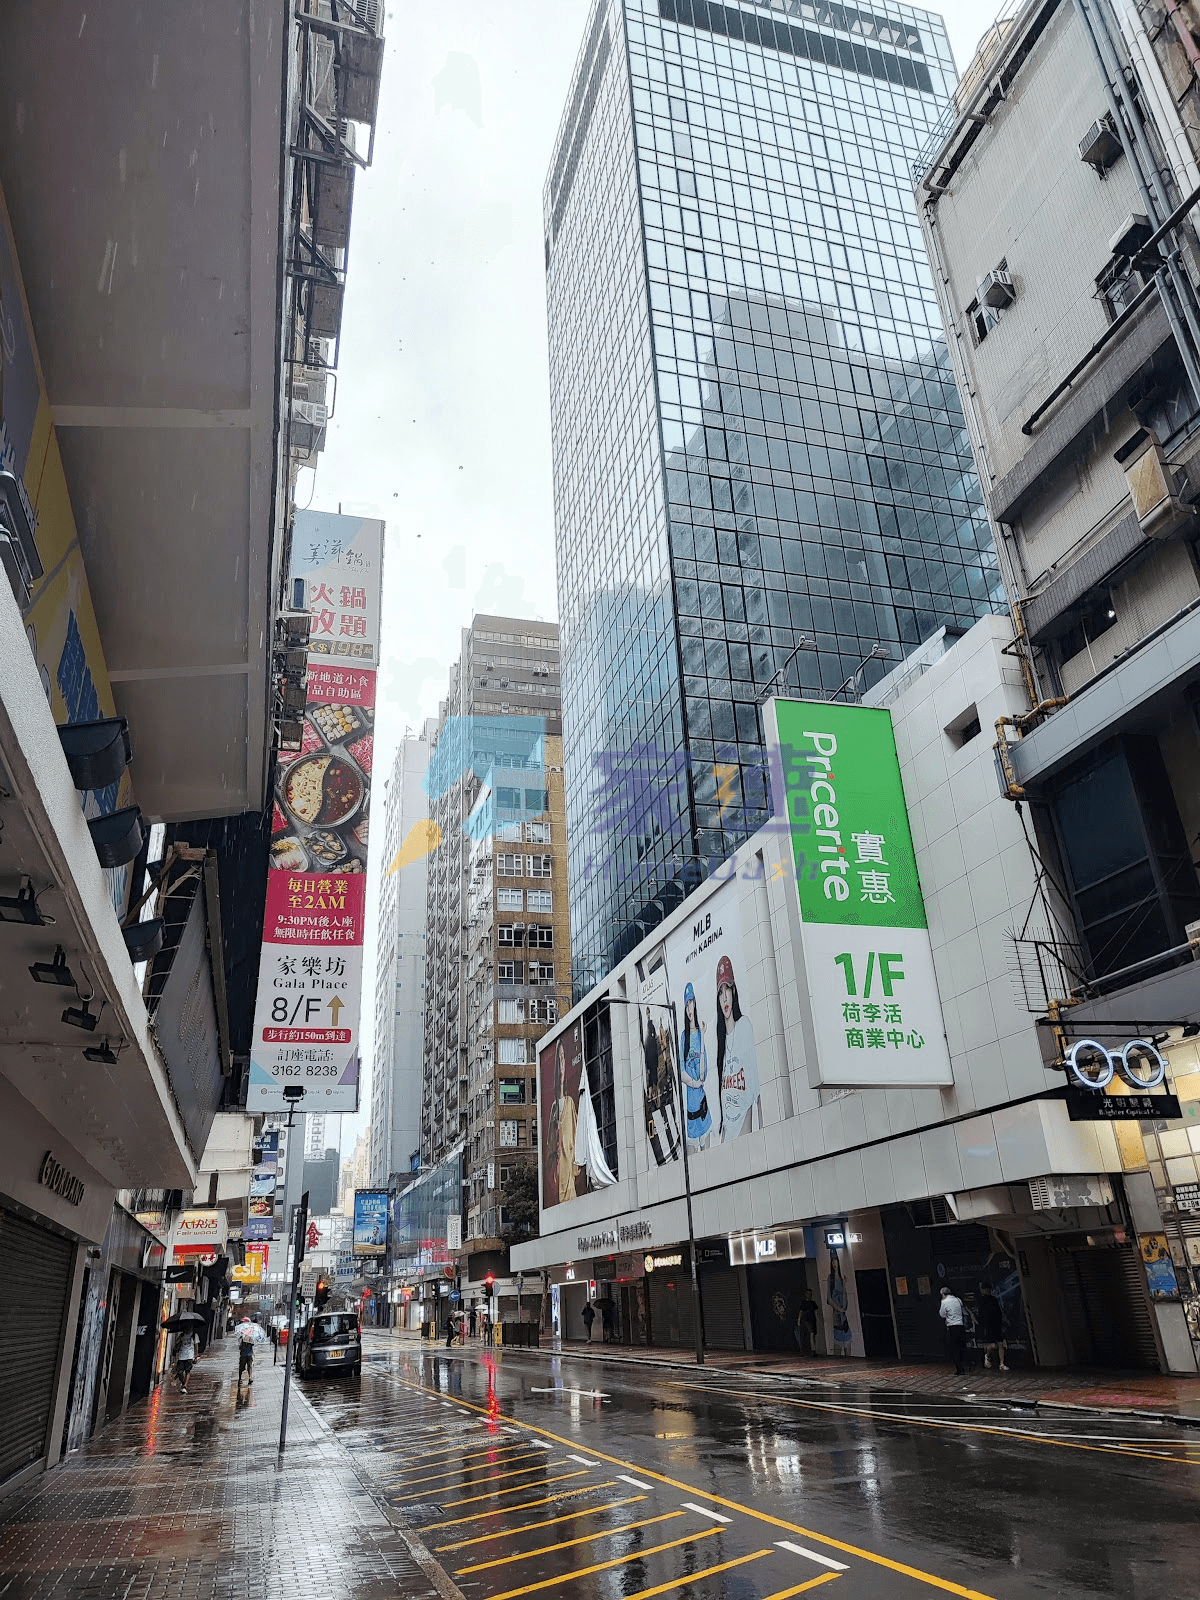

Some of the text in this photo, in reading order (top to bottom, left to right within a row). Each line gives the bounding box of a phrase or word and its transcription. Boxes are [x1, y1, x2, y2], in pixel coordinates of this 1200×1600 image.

[310, 583, 367, 610] 火鍋
[803, 730, 850, 902] Pricerite
[850, 829, 896, 904] 實惠
[288, 878, 349, 894] 每日營業
[288, 895, 346, 909] 至2AM
[277, 915, 354, 927] 9:30PM後入座
[693, 912, 711, 942] MLB
[273, 927, 355, 940] 無限時任飲任食
[685, 926, 723, 964] WITH KARINA
[277, 955, 347, 977] 家樂坊
[834, 951, 905, 998] 1/F
[273, 977, 348, 989] Gala Place
[271, 994, 322, 1026] 8/F
[841, 1002, 903, 1025] 荷李活
[267, 1029, 346, 1042] 步行約150m到達
[845, 1027, 926, 1050] 商業中心
[271, 1065, 338, 1077] 3162 8238
[40, 1150, 85, 1205] GIORDANO
[178, 1218, 218, 1230] 大快活
[756, 1239, 776, 1256] MLB
[231, 1257, 260, 1276] csl.
